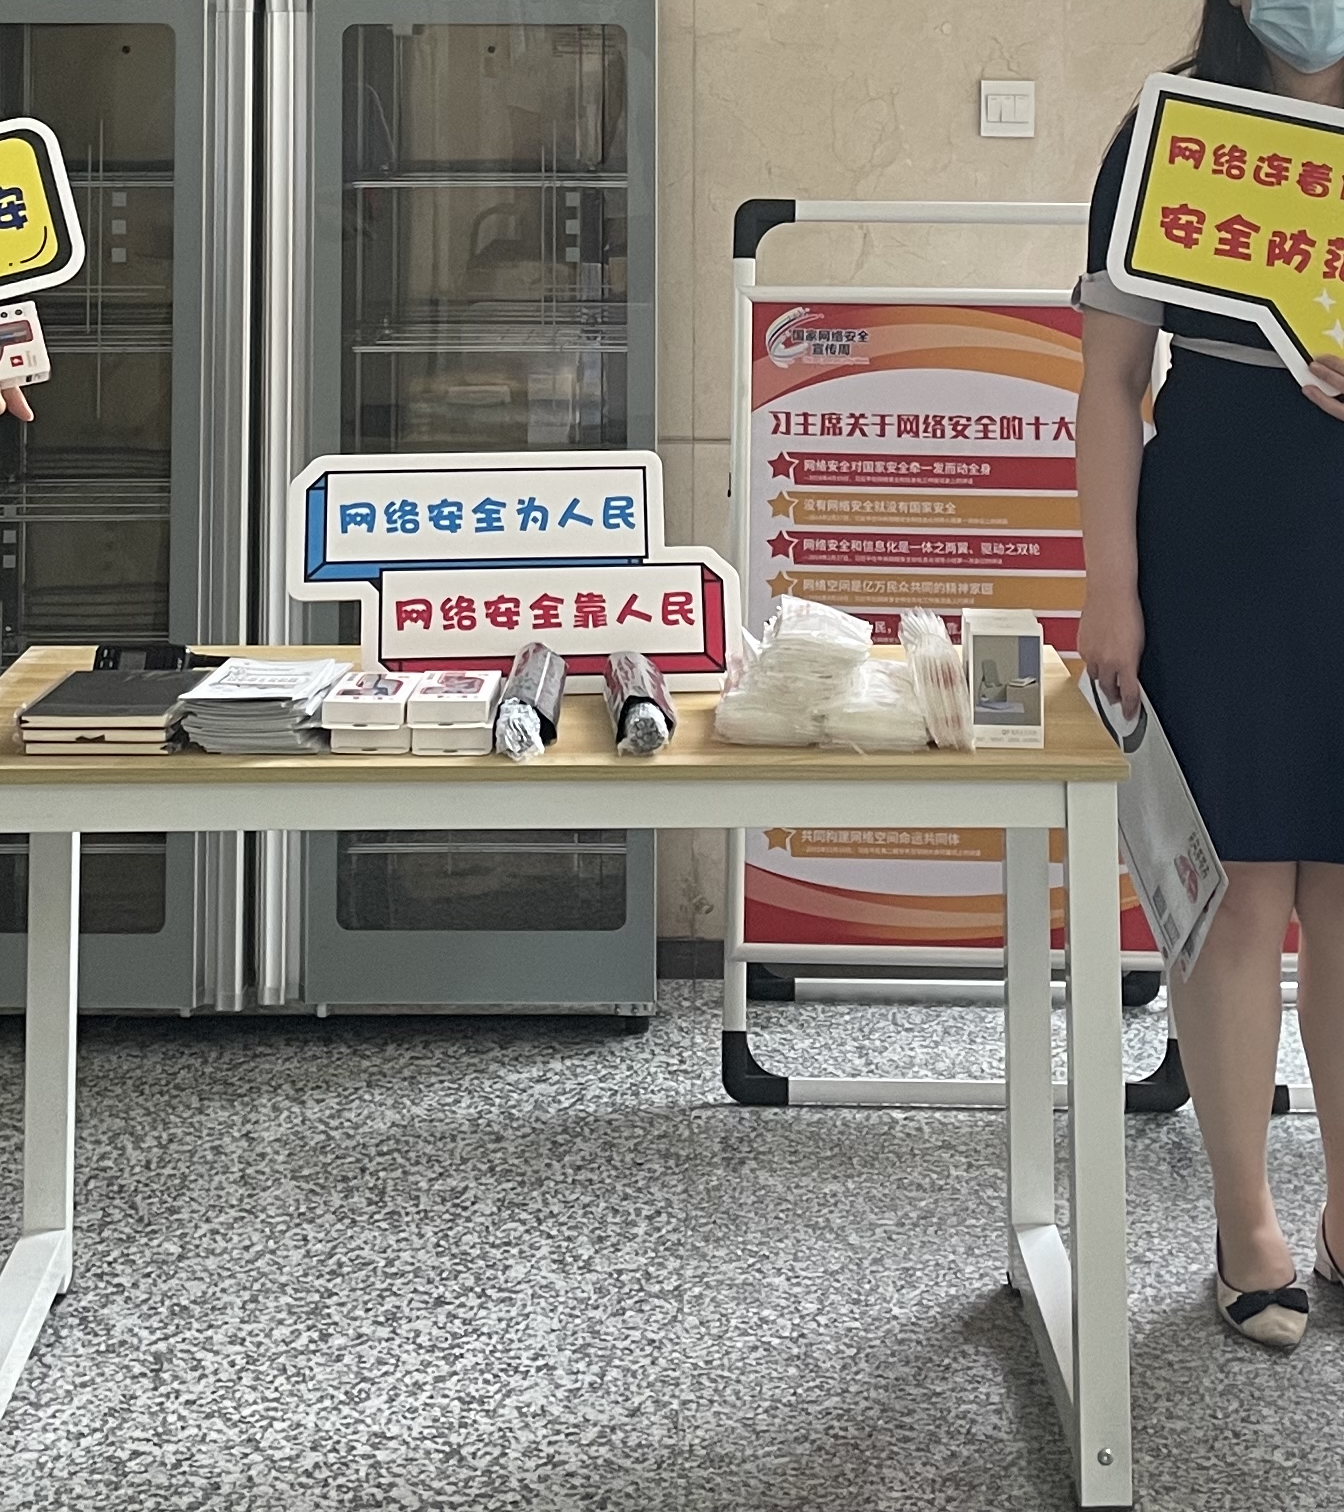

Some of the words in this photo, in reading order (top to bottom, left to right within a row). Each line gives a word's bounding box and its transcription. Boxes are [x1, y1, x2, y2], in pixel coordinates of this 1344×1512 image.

[791, 329, 869, 343] 国家网络安全
[812, 343, 851, 356] 宣传周
[768, 410, 1076, 441] 习主席关于网络安全的十大
[803, 459, 991, 476] 网络安全对国家安全牵一发而动全身
[339, 495, 637, 534] 网络安全为人民
[803, 499, 956, 514] 没有网络安全就没有国家安全
[803, 539, 1041, 556] 网络安全和信息化是一体之两翼、驱动之双轮
[803, 578, 994, 595] 网络空间是亿万民众共同的精神家园
[395, 591, 696, 632] 网络安全靠人民
[801, 829, 961, 846] 共同构建网络空间命运共同体
